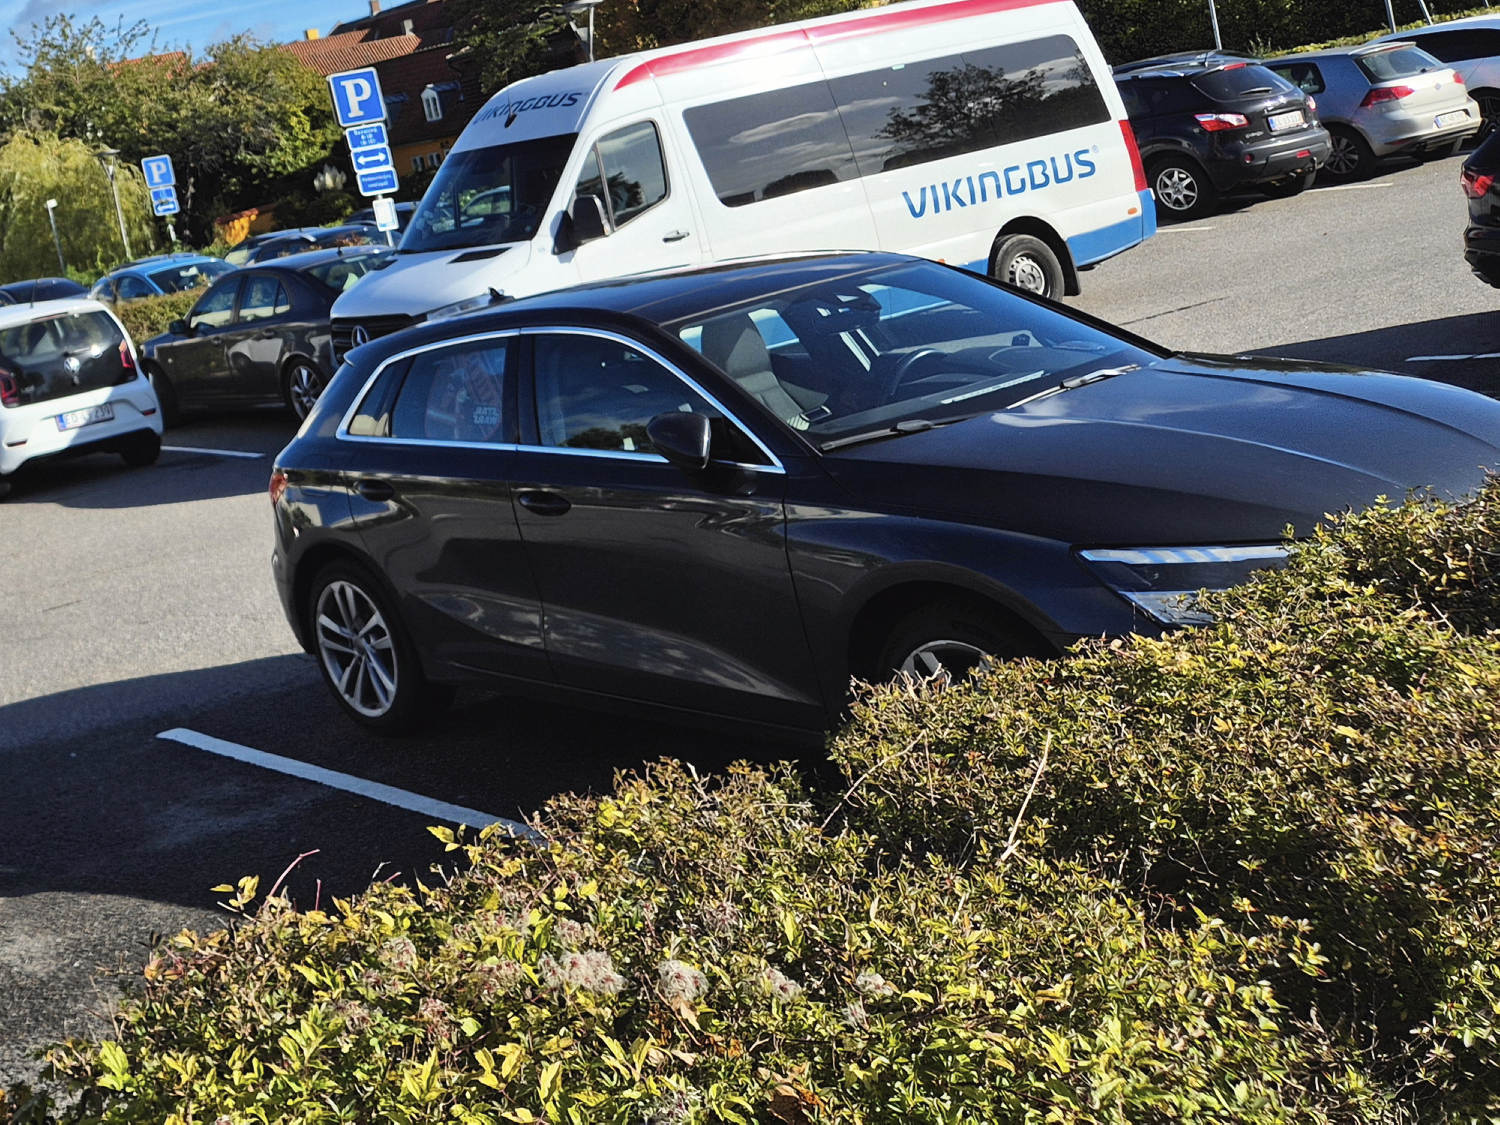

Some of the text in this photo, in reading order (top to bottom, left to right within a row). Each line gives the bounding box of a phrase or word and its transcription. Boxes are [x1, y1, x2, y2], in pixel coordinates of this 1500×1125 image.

[340, 77, 372, 118] P
[147, 161, 167, 183] P
[901, 148, 1097, 219] VIKINGBUS
